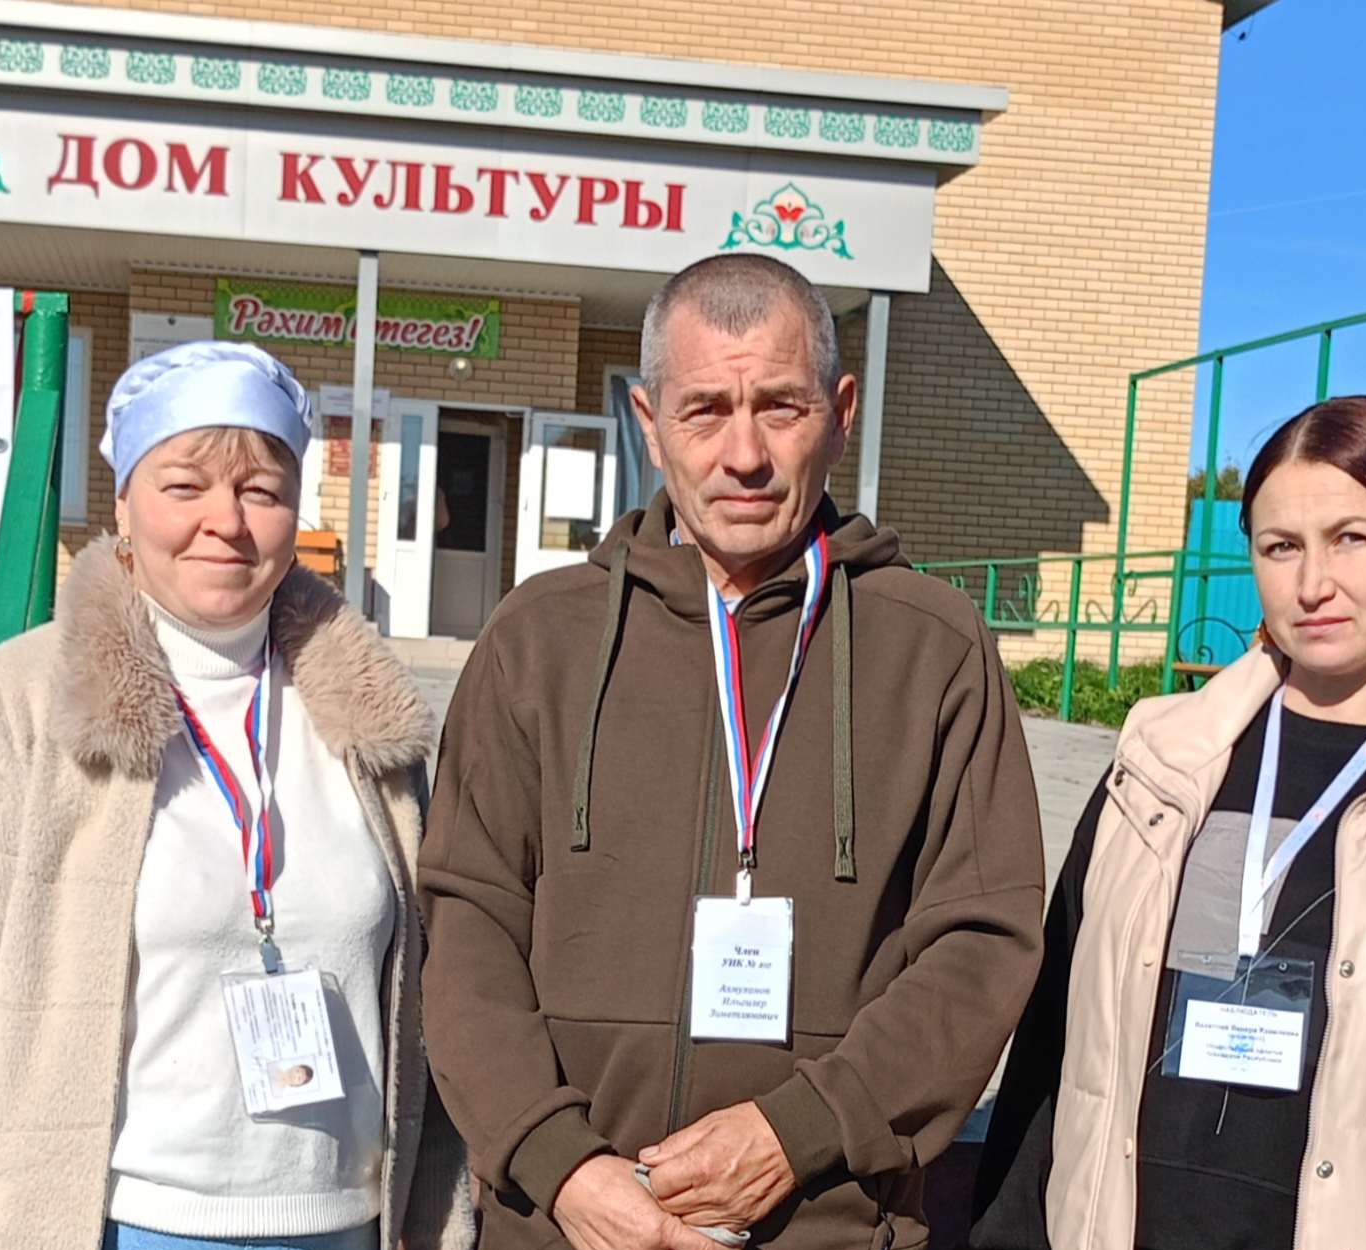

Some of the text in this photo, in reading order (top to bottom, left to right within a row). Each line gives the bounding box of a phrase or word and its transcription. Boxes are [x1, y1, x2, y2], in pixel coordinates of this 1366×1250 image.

[47, 133, 686, 233] ДОМ КУЛЬТУРЫ
[233, 298, 344, 338] Рәхим
[734, 945, 760, 956] Член
[1219, 1006, 1278, 1018] НАБЛЮДАТЕЛЬ
